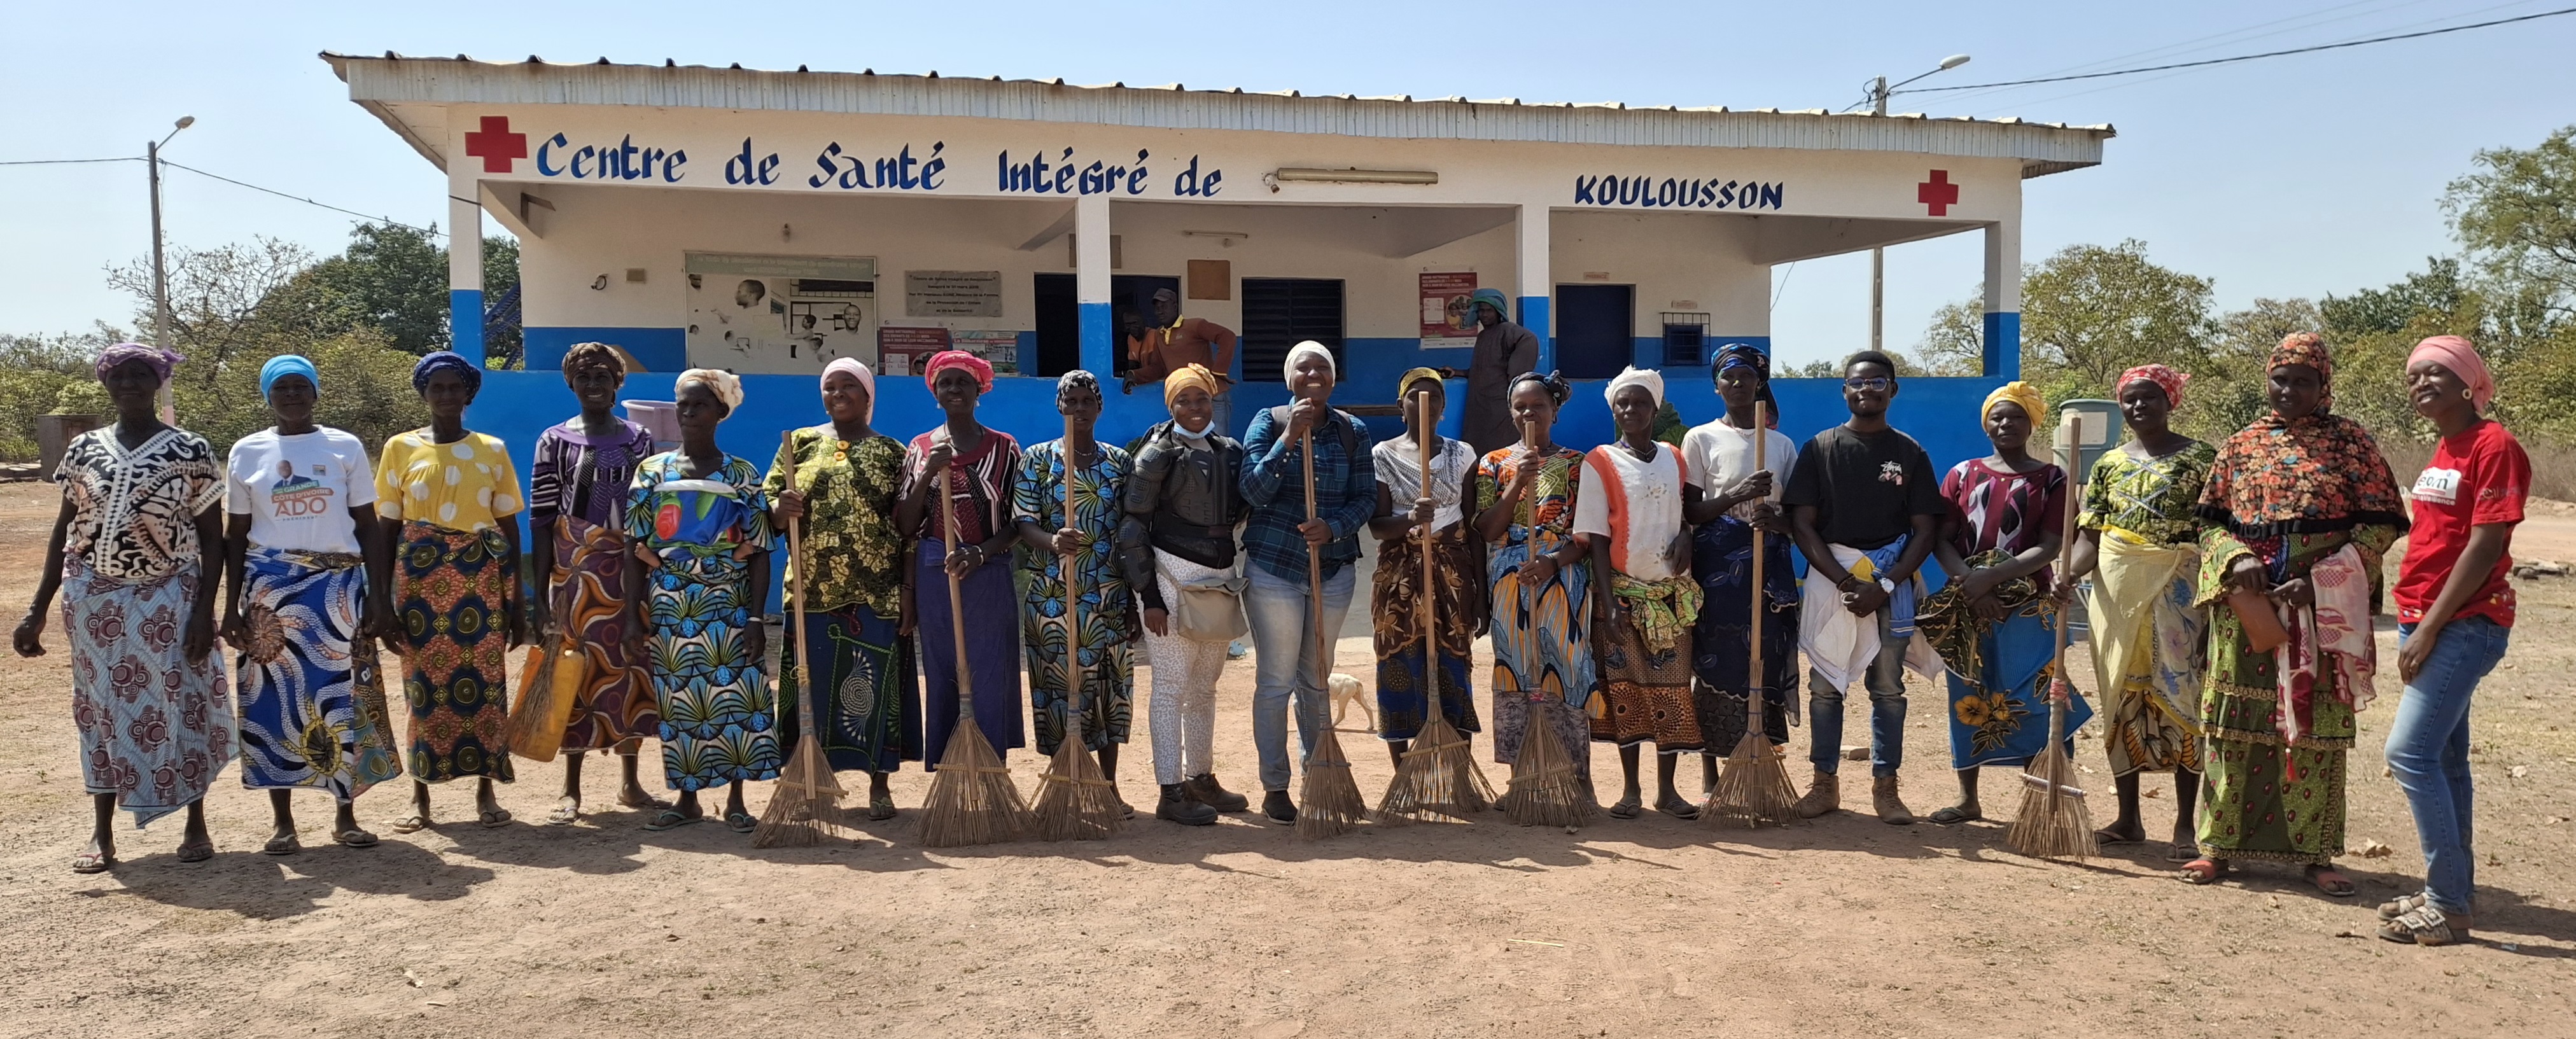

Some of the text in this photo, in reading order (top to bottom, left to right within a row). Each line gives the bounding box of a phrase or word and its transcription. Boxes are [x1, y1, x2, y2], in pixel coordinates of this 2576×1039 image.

[536, 132, 687, 183] Centre
[725, 136, 780, 186] de
[808, 141, 946, 190] Santé
[1174, 154, 1222, 197] de
[1574, 174, 1784, 210] KOULOUSSON
[284, 481, 318, 492] GRANDE
[274, 497, 326, 517] ADO
